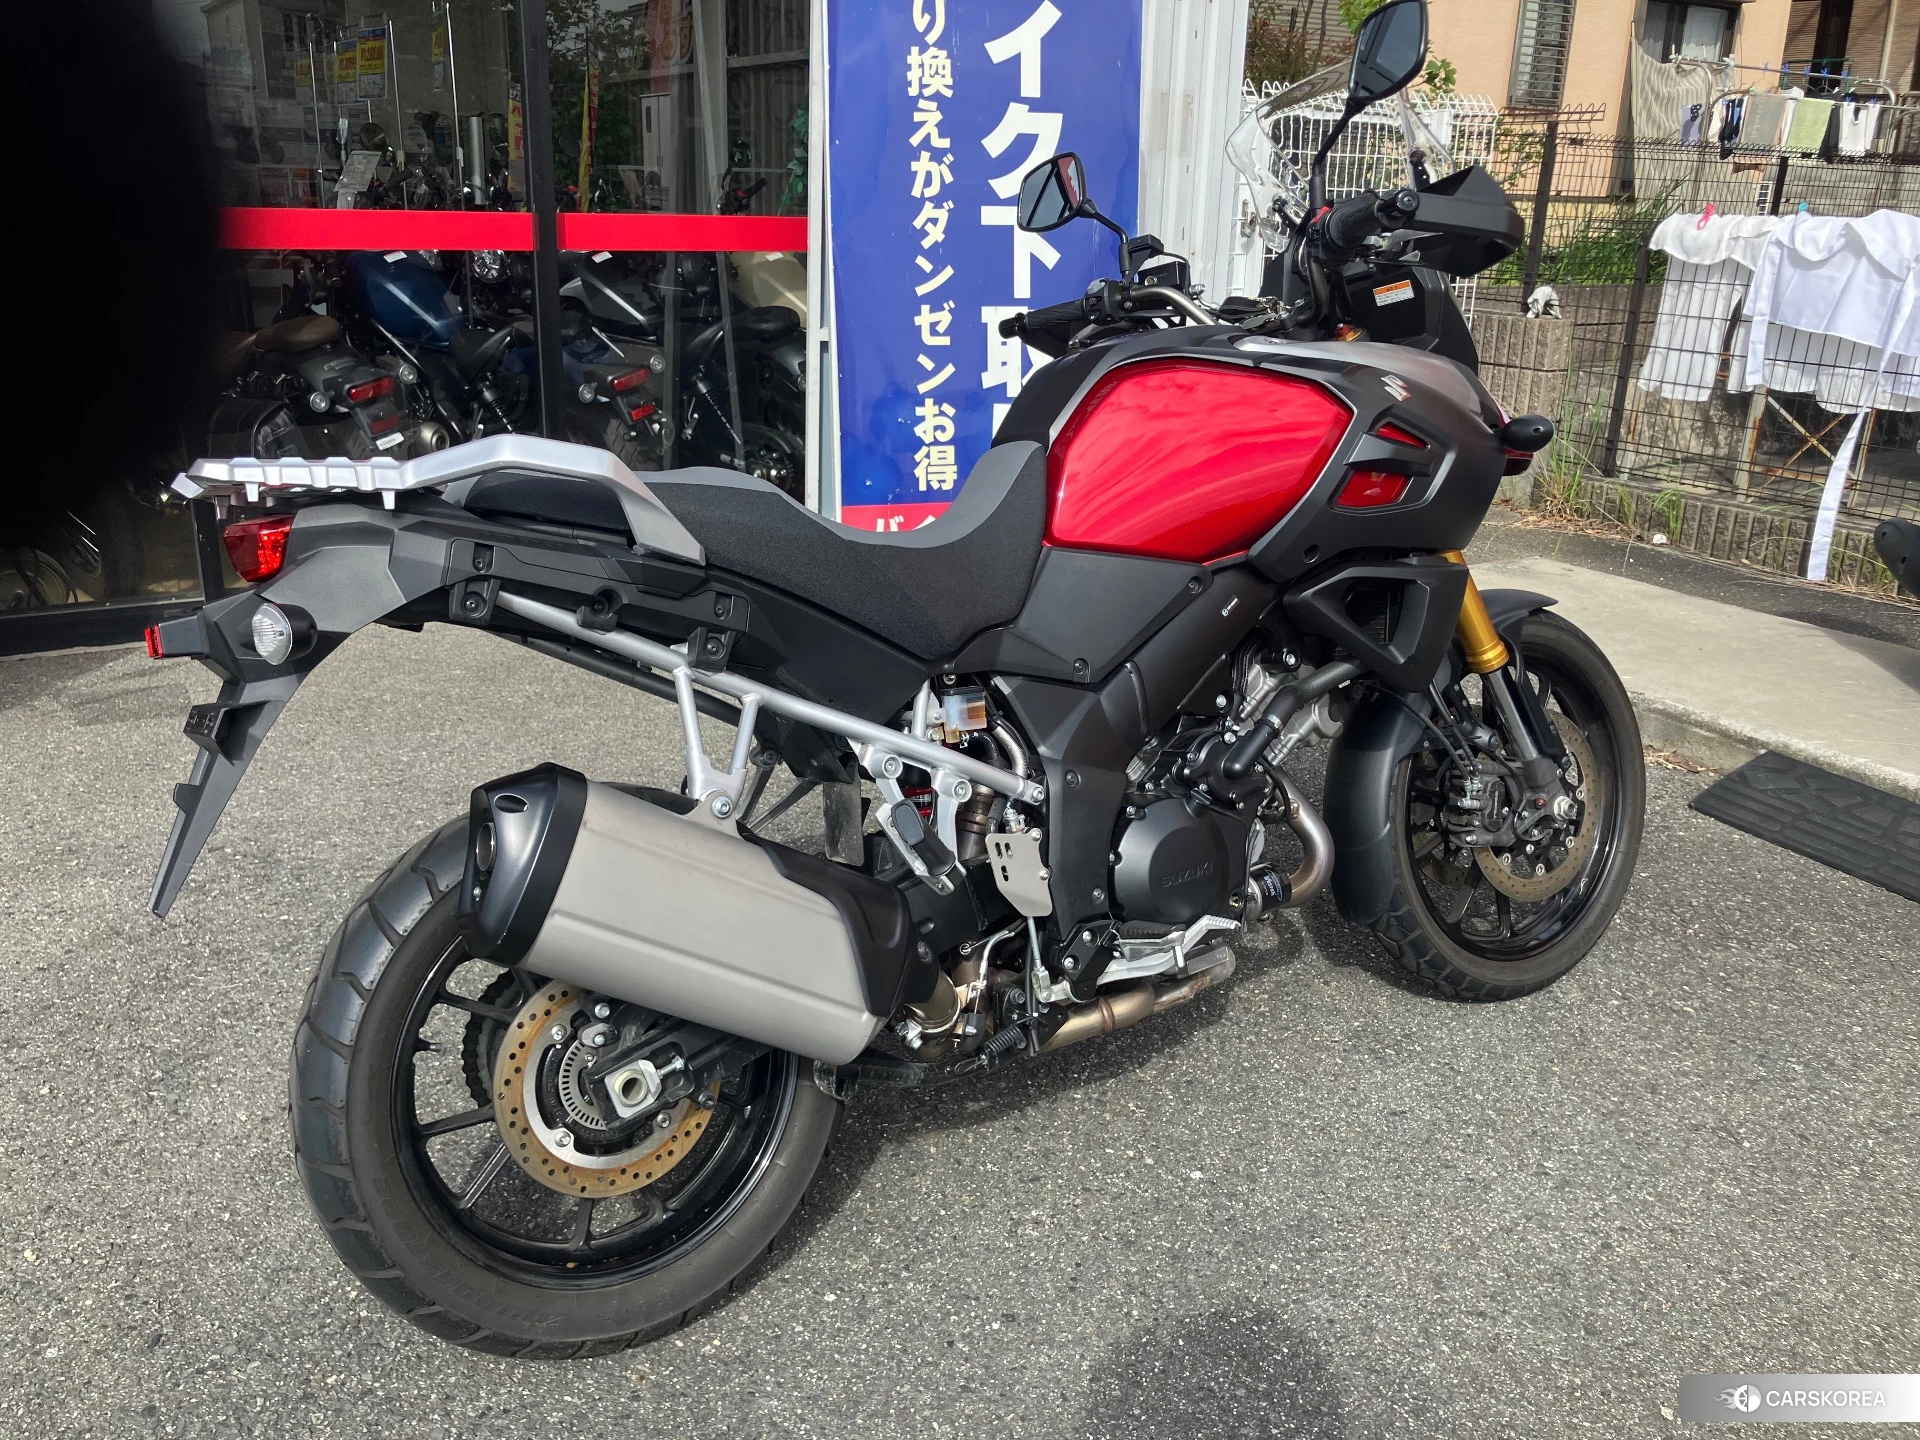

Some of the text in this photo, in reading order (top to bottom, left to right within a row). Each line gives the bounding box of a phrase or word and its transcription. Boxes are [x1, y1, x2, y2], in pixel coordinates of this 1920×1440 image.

[907, 0, 957, 491] り換えがダンゼンお得
[980, 0, 1063, 440] イク下取
[1161, 861, 1214, 888] SUZUKI
